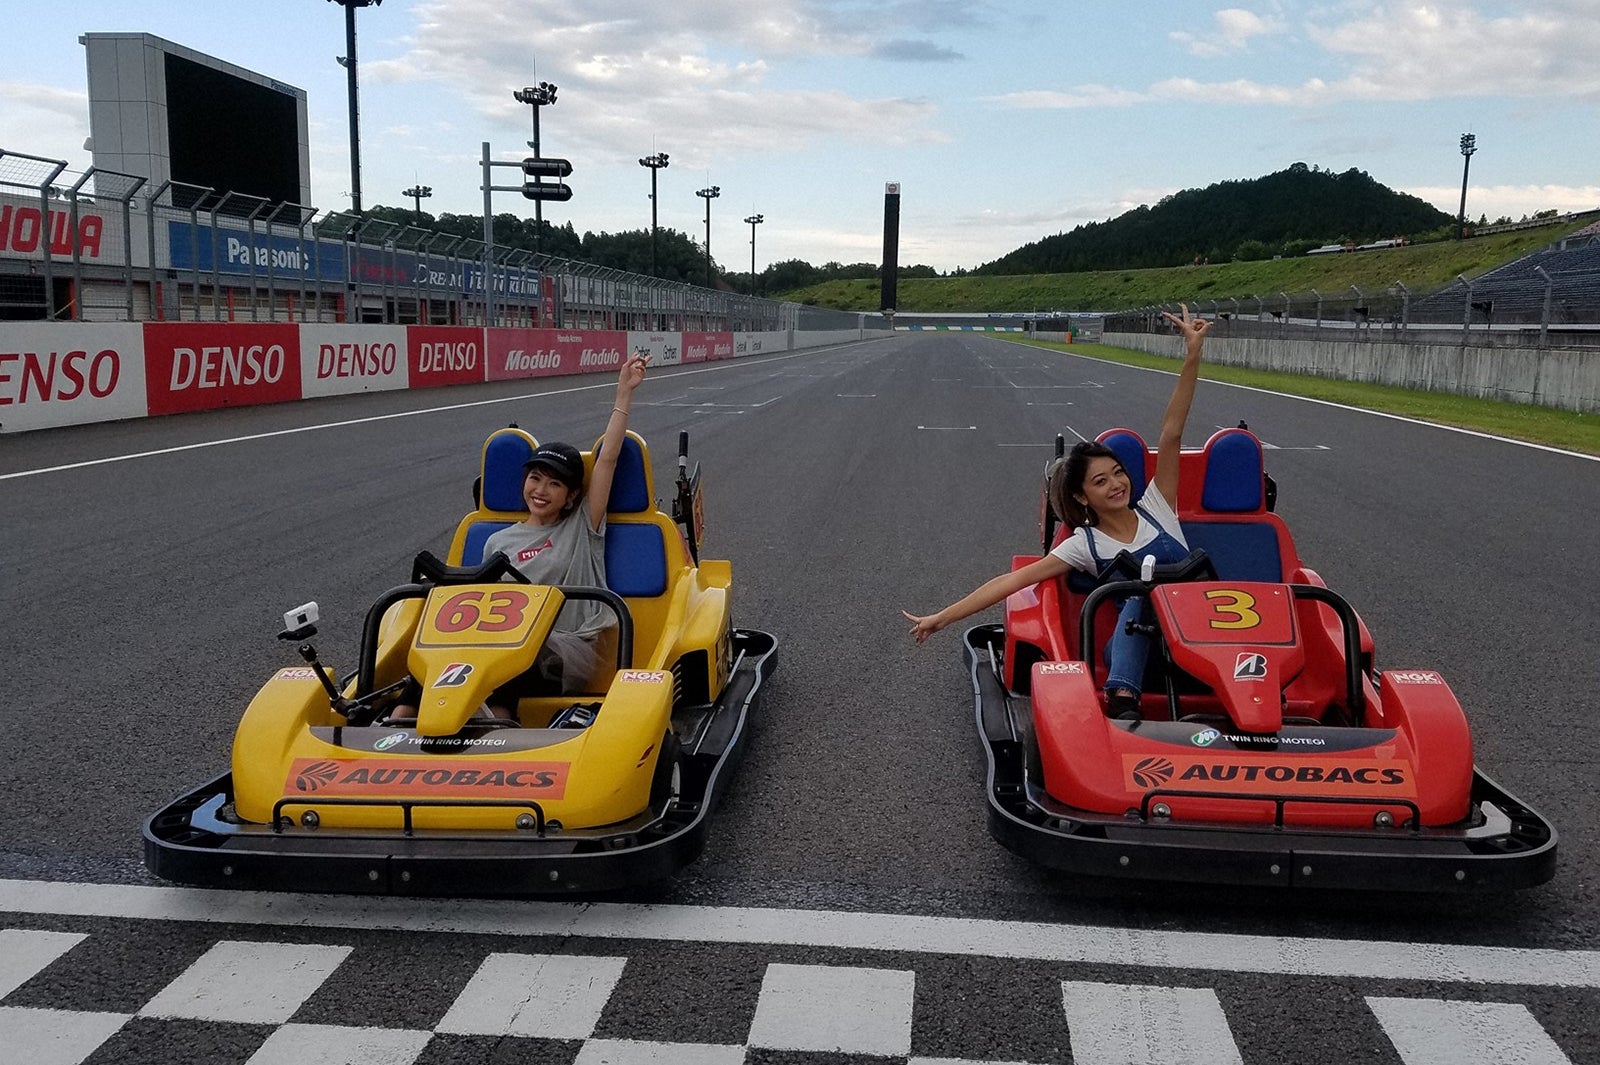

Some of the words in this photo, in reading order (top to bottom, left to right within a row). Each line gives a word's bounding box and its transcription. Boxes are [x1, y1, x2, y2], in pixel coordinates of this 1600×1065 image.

[412, 263, 462, 287] DREM
[317, 343, 396, 379] DENSO
[419, 342, 477, 372] DENSO
[505, 349, 561, 370] Modulo
[579, 348, 620, 366] Modulo
[686, 345, 708, 358] Modulo
[169, 344, 285, 391] DENSO
[434, 591, 530, 633] 63
[1204, 588, 1263, 630] 3
[623, 671, 664, 680] NGK
[1041, 663, 1081, 672] NGK
[1394, 673, 1437, 681] NGK
[1222, 734, 1251, 742] TWIN
[1281, 737, 1326, 745] MOTEGI
[339, 768, 558, 789] AUTOBACS
[1178, 763, 1405, 785] AUTOBACS
